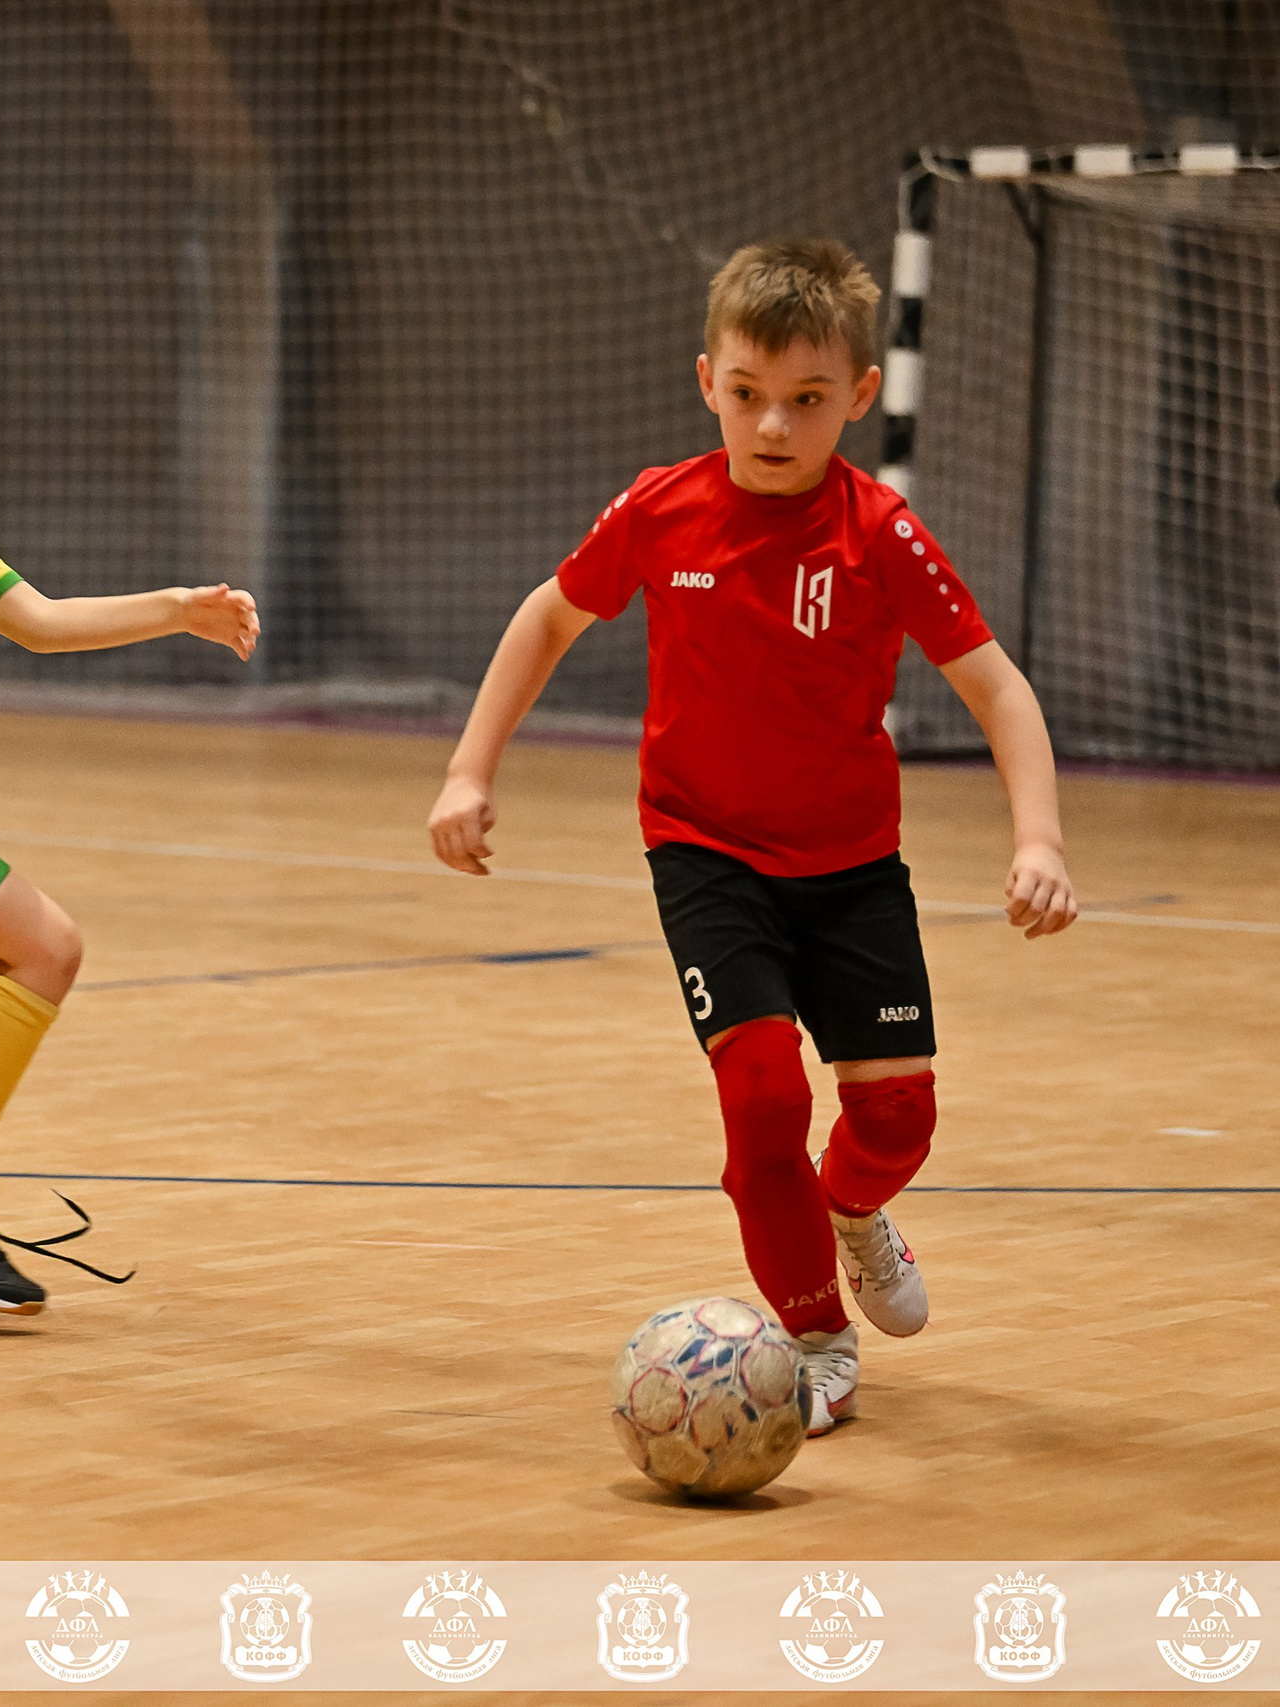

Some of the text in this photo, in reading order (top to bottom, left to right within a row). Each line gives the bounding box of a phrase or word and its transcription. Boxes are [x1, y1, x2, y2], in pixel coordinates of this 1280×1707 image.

[670, 571, 715, 589] JAKO
[684, 966, 713, 1021] 3
[876, 1005, 920, 1023] JAKO
[782, 1278, 838, 1310] JAKO
